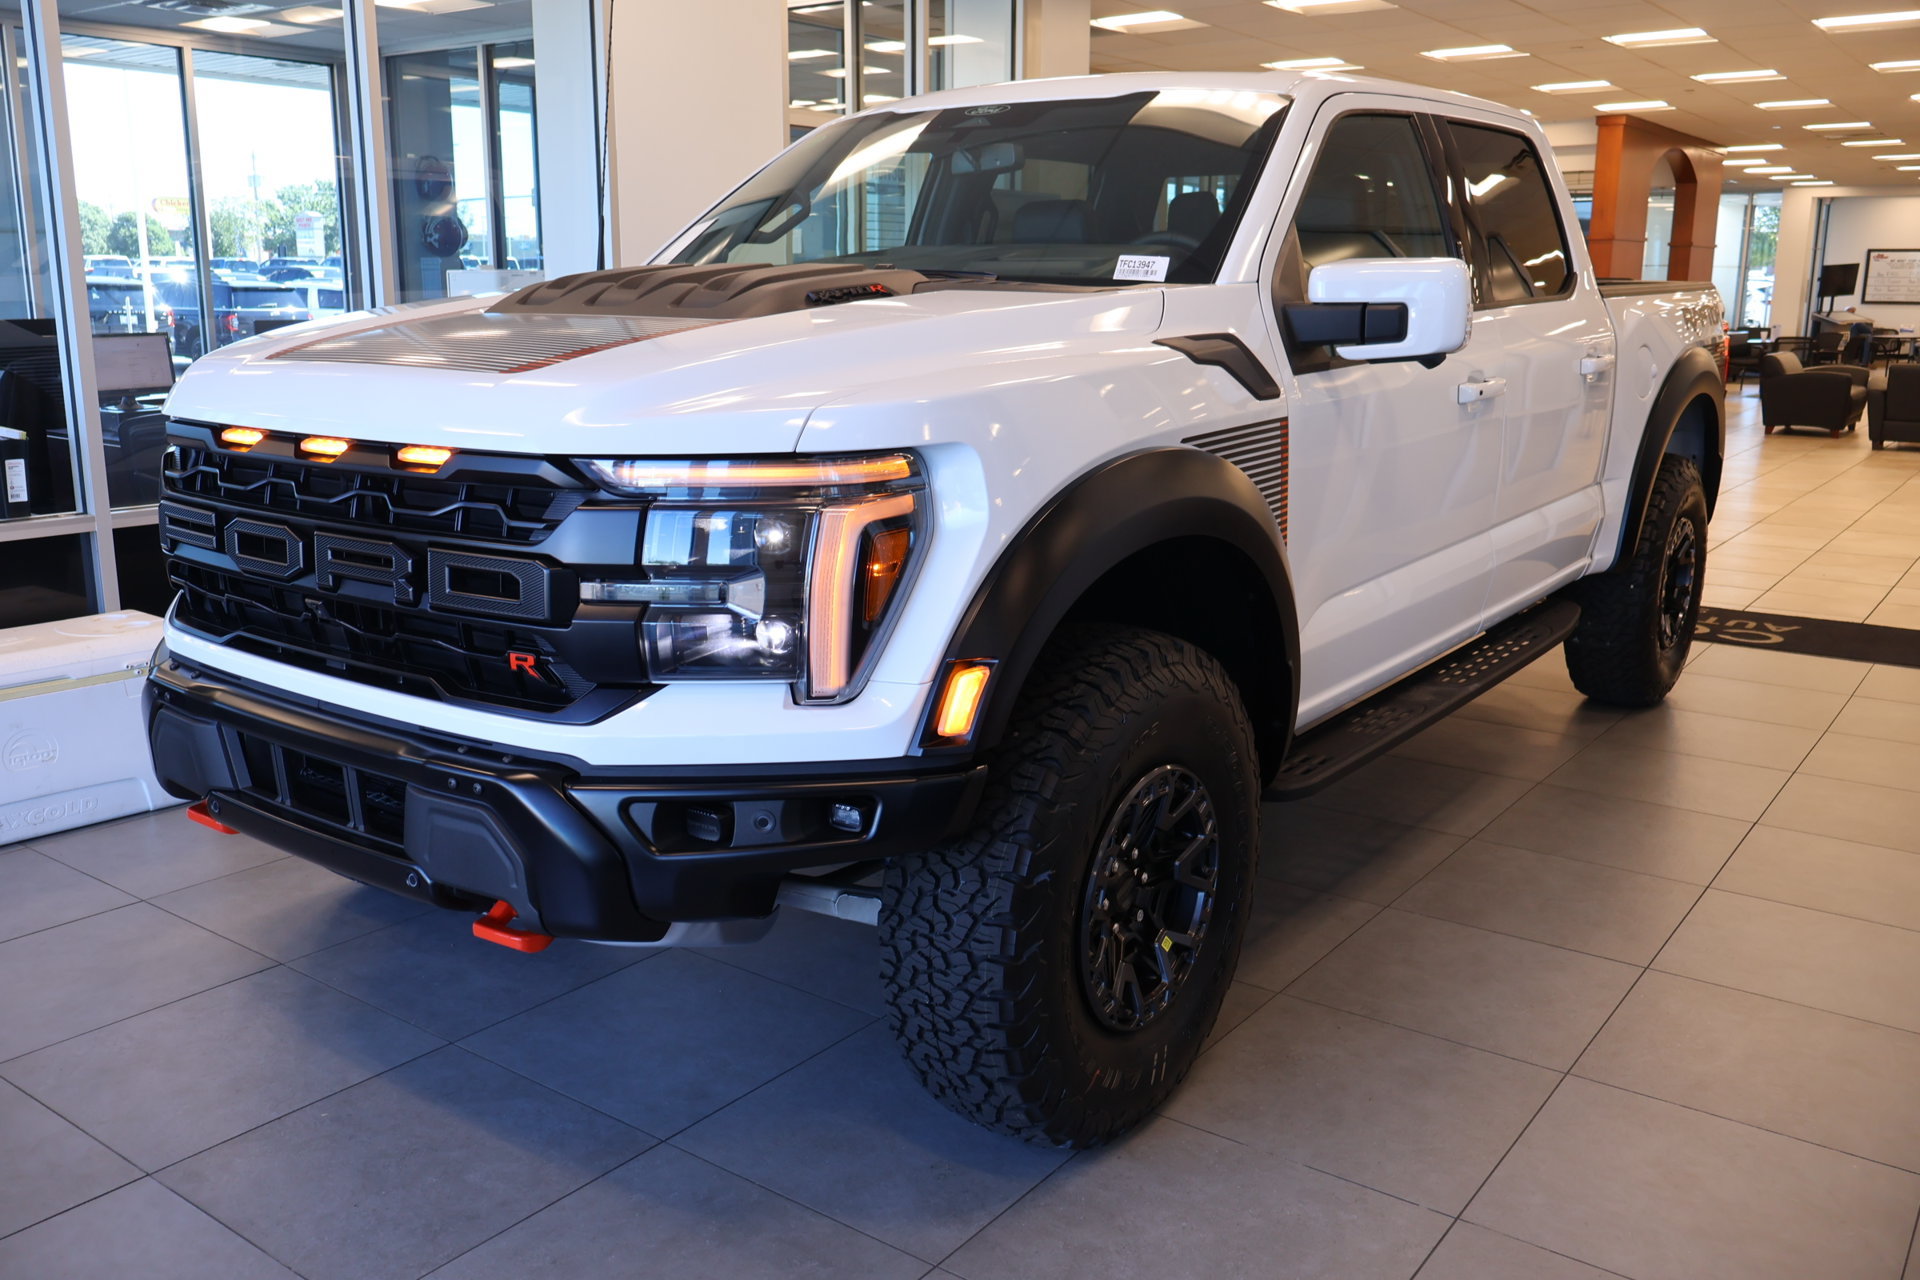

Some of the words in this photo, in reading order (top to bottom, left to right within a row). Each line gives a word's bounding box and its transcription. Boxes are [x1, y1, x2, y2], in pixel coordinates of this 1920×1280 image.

[1119, 260, 1155, 269] TFC13947
[159, 500, 553, 621] FORD
[509, 652, 543, 681] R
